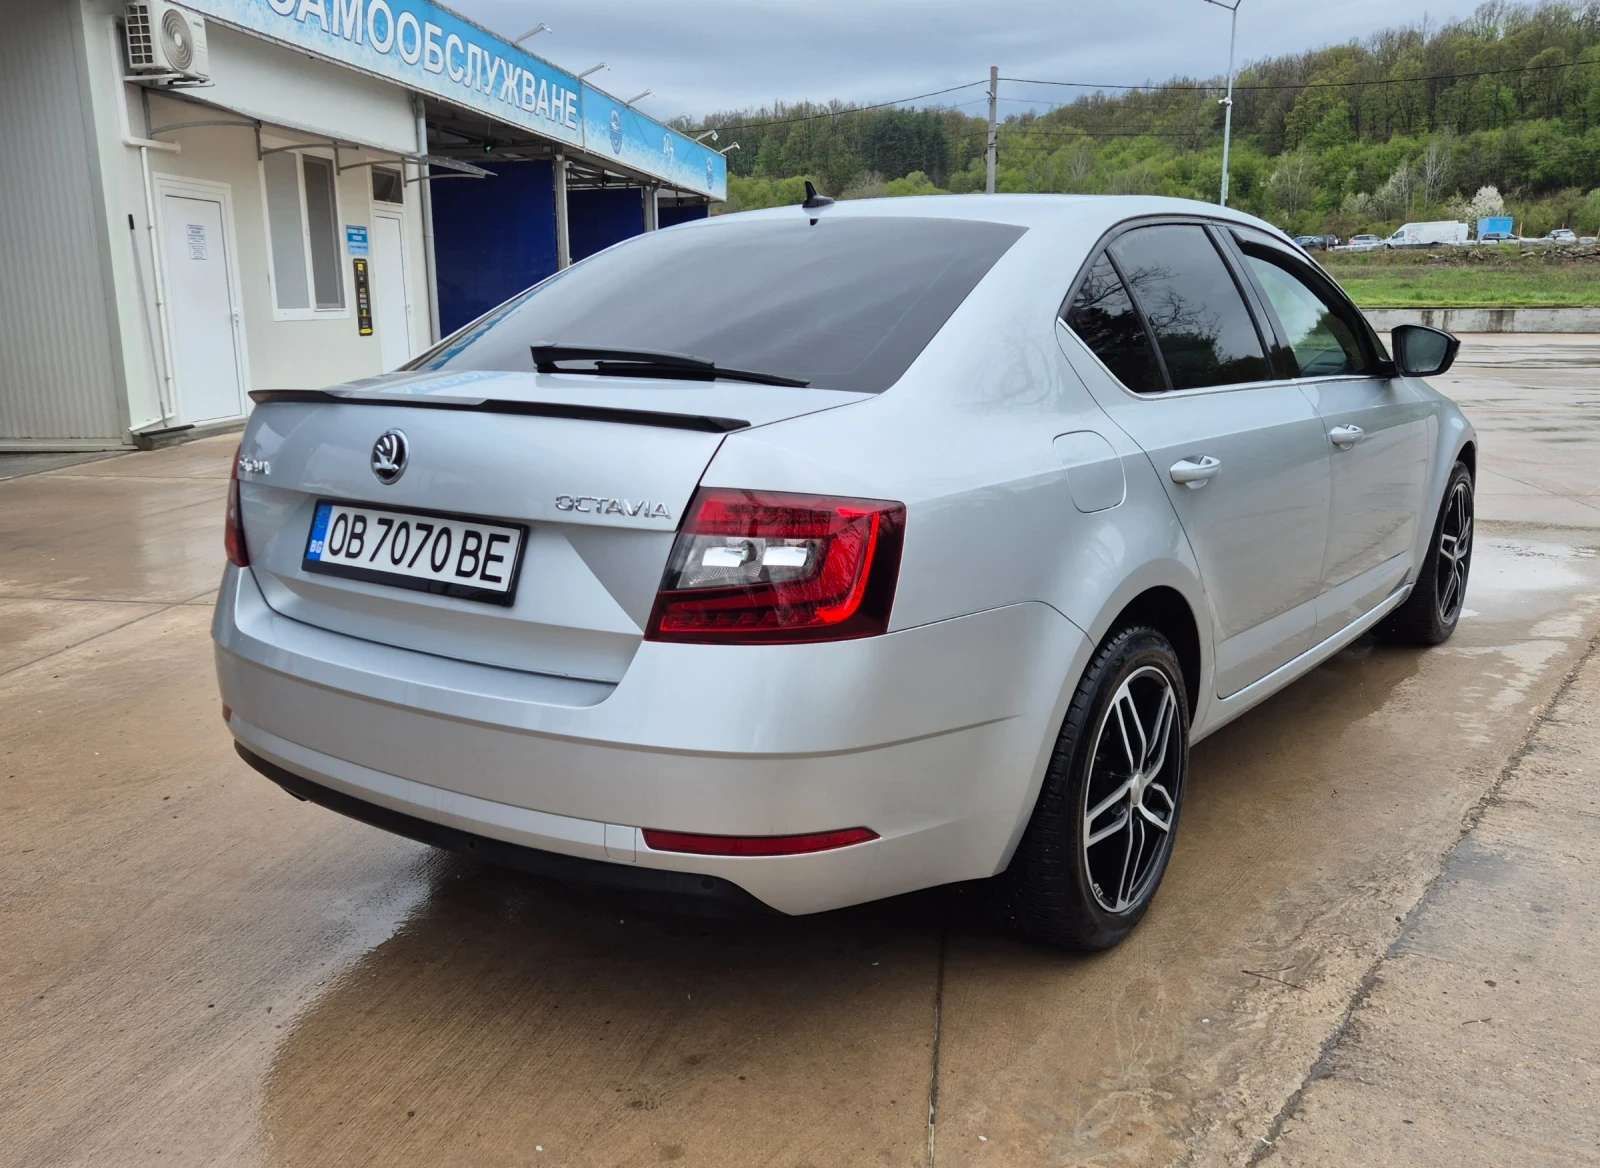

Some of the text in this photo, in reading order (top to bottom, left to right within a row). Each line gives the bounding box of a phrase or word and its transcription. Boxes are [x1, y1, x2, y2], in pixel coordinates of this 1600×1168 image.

[267, 0, 577, 130] АМООБСЛУЖВАНЕ
[555, 494, 672, 519] OCTAVIA
[309, 539, 324, 554] BG
[328, 512, 511, 584] OB 7070 BE
